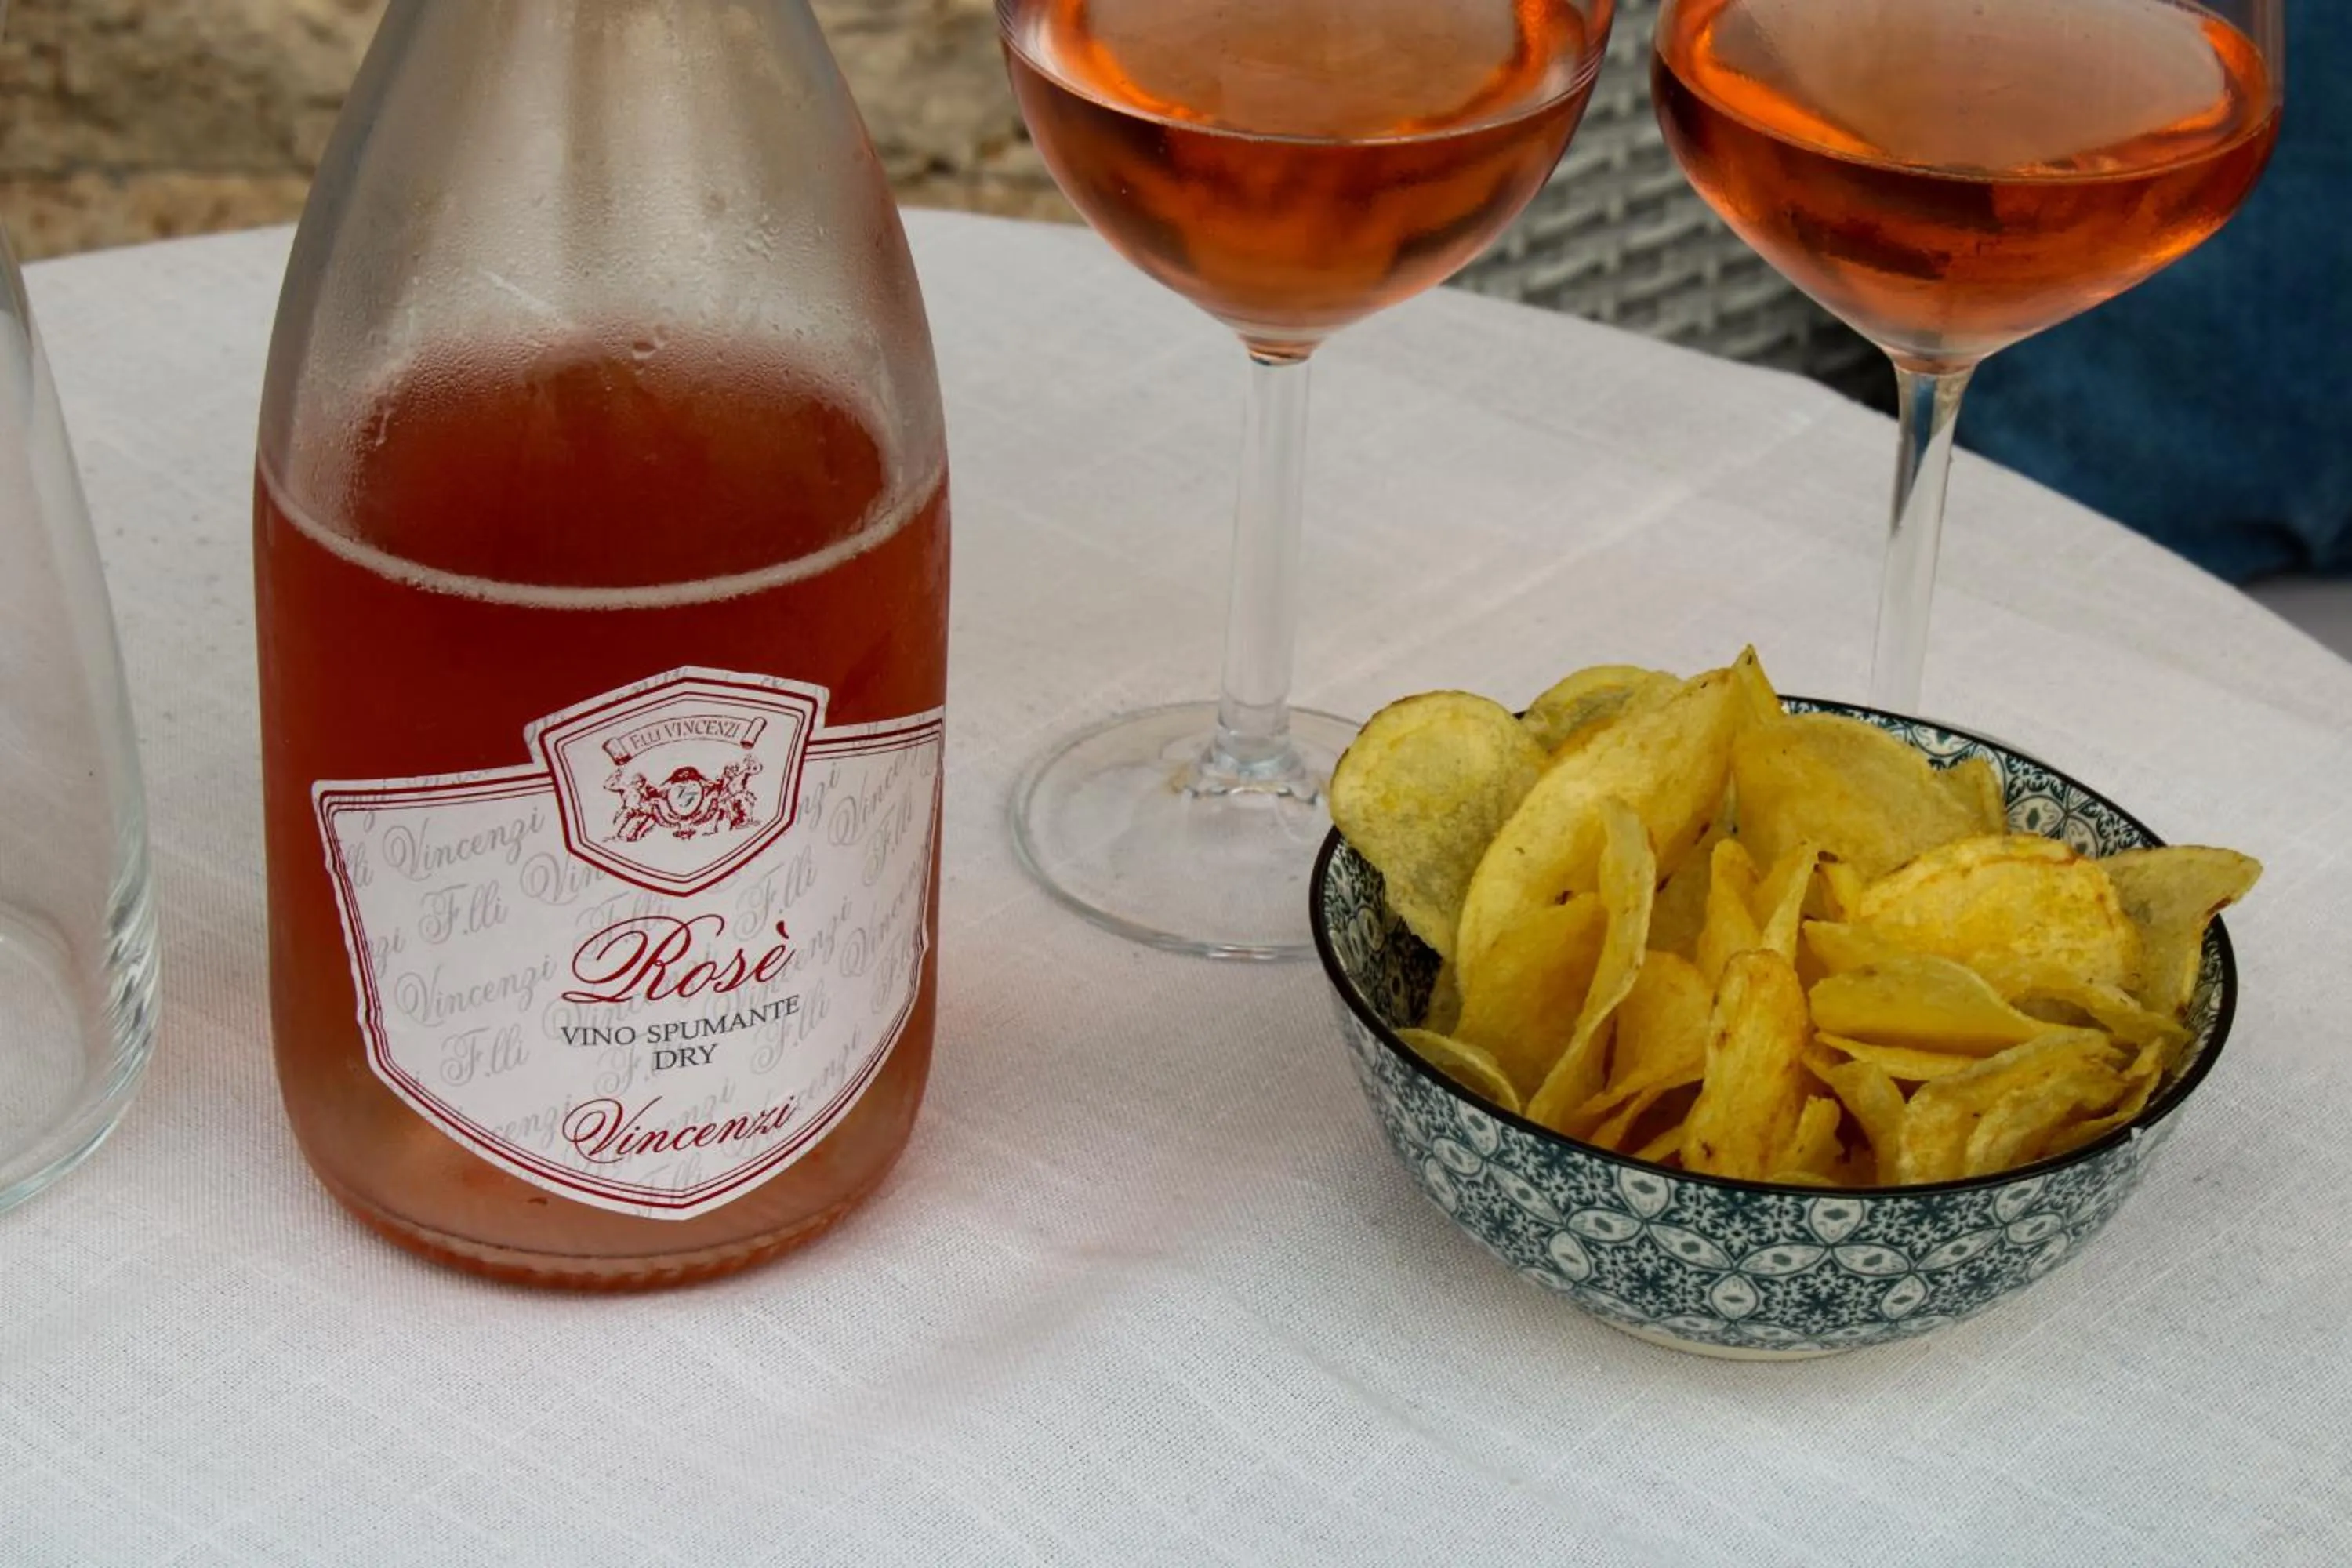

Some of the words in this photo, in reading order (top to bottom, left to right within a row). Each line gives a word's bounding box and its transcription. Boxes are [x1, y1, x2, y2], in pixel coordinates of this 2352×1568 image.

[664, 718, 741, 739] VINCENZI
[382, 806, 546, 882] Vincenzi
[418, 880, 509, 945] F.lli
[394, 953, 557, 1028] Vincenzi
[561, 913, 796, 1004] Rosè
[560, 1025, 637, 1047] VINO
[646, 994, 800, 1044] SPUMANTE
[439, 1023, 531, 1087] F.lli
[652, 1043, 719, 1071] DRY
[562, 1094, 798, 1164] Vincenzi
